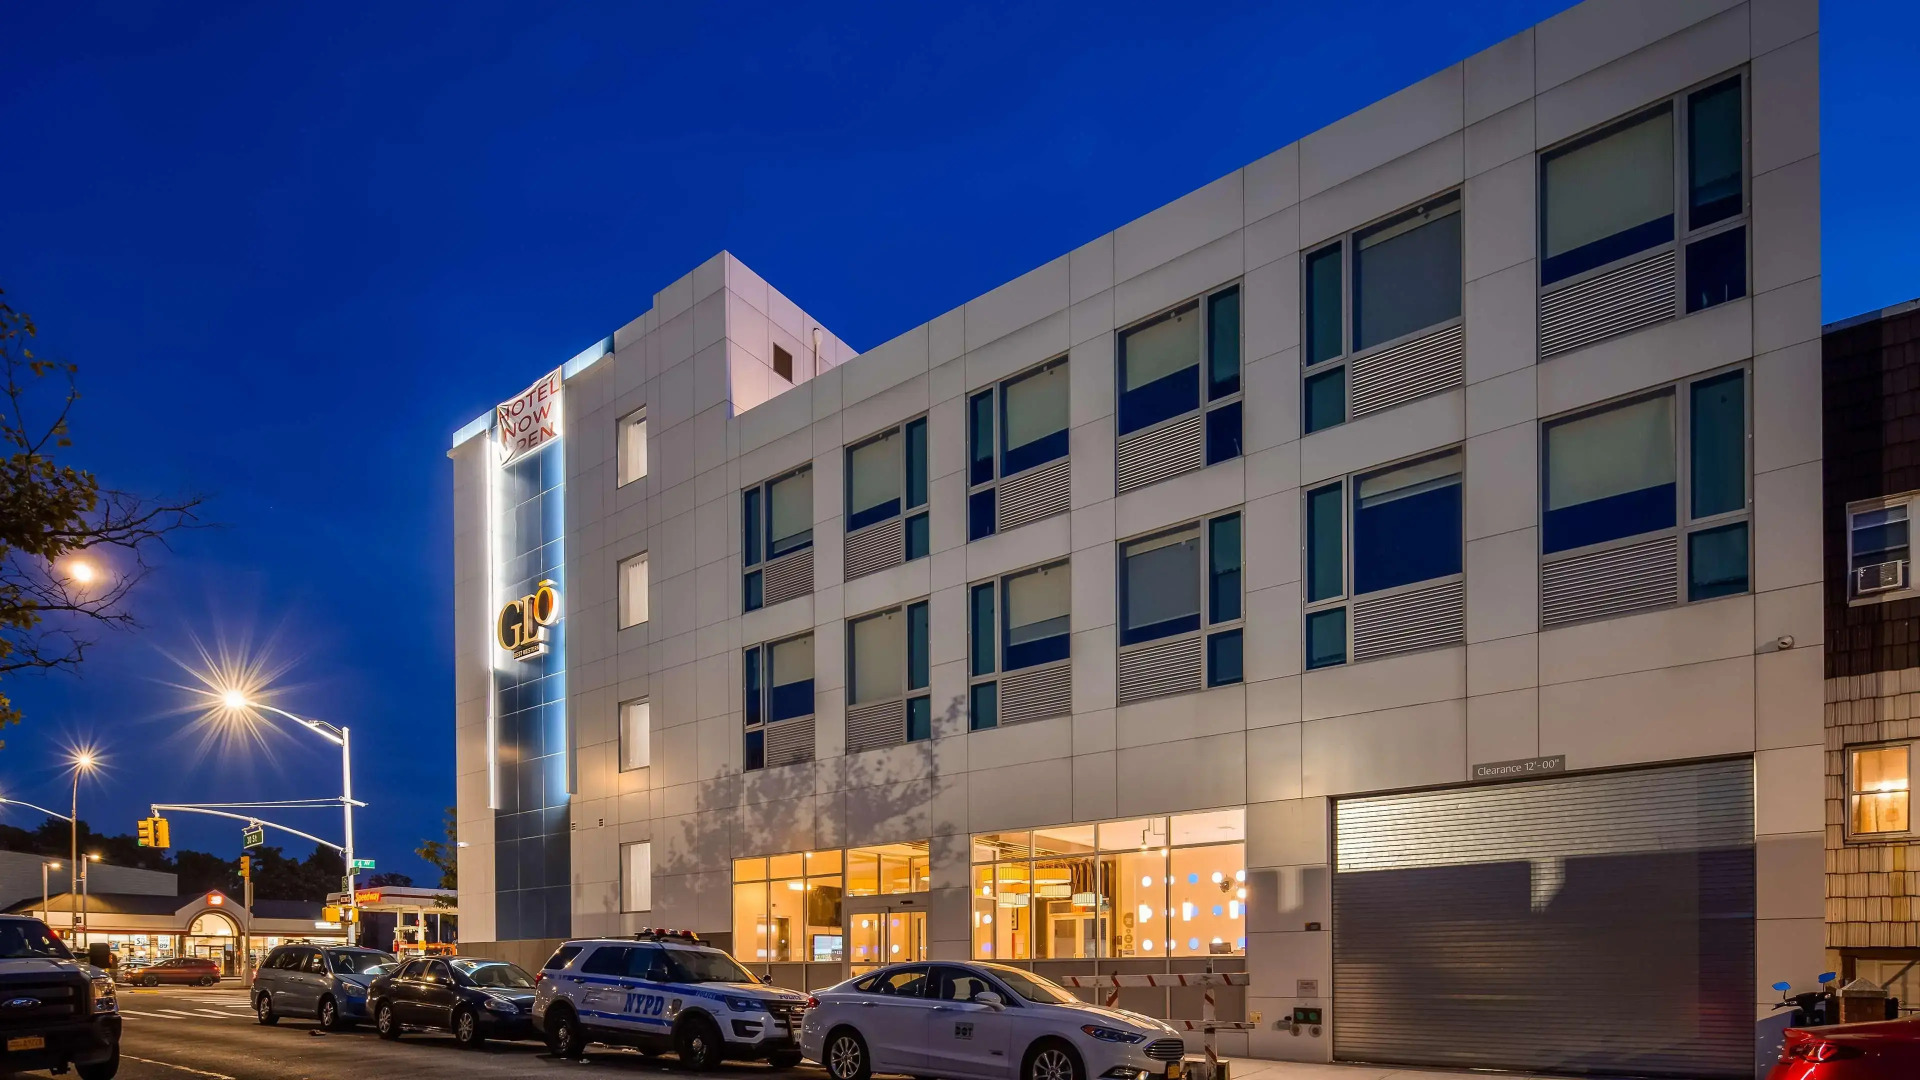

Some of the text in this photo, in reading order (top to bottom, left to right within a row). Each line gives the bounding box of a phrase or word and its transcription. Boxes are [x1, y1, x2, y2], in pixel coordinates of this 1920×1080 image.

[499, 378, 560, 421] HOTEL
[503, 402, 552, 443] NOW
[516, 422, 554, 449] PEN
[1477, 764, 1522, 776] Clearance
[623, 992, 665, 1016] NYPD
